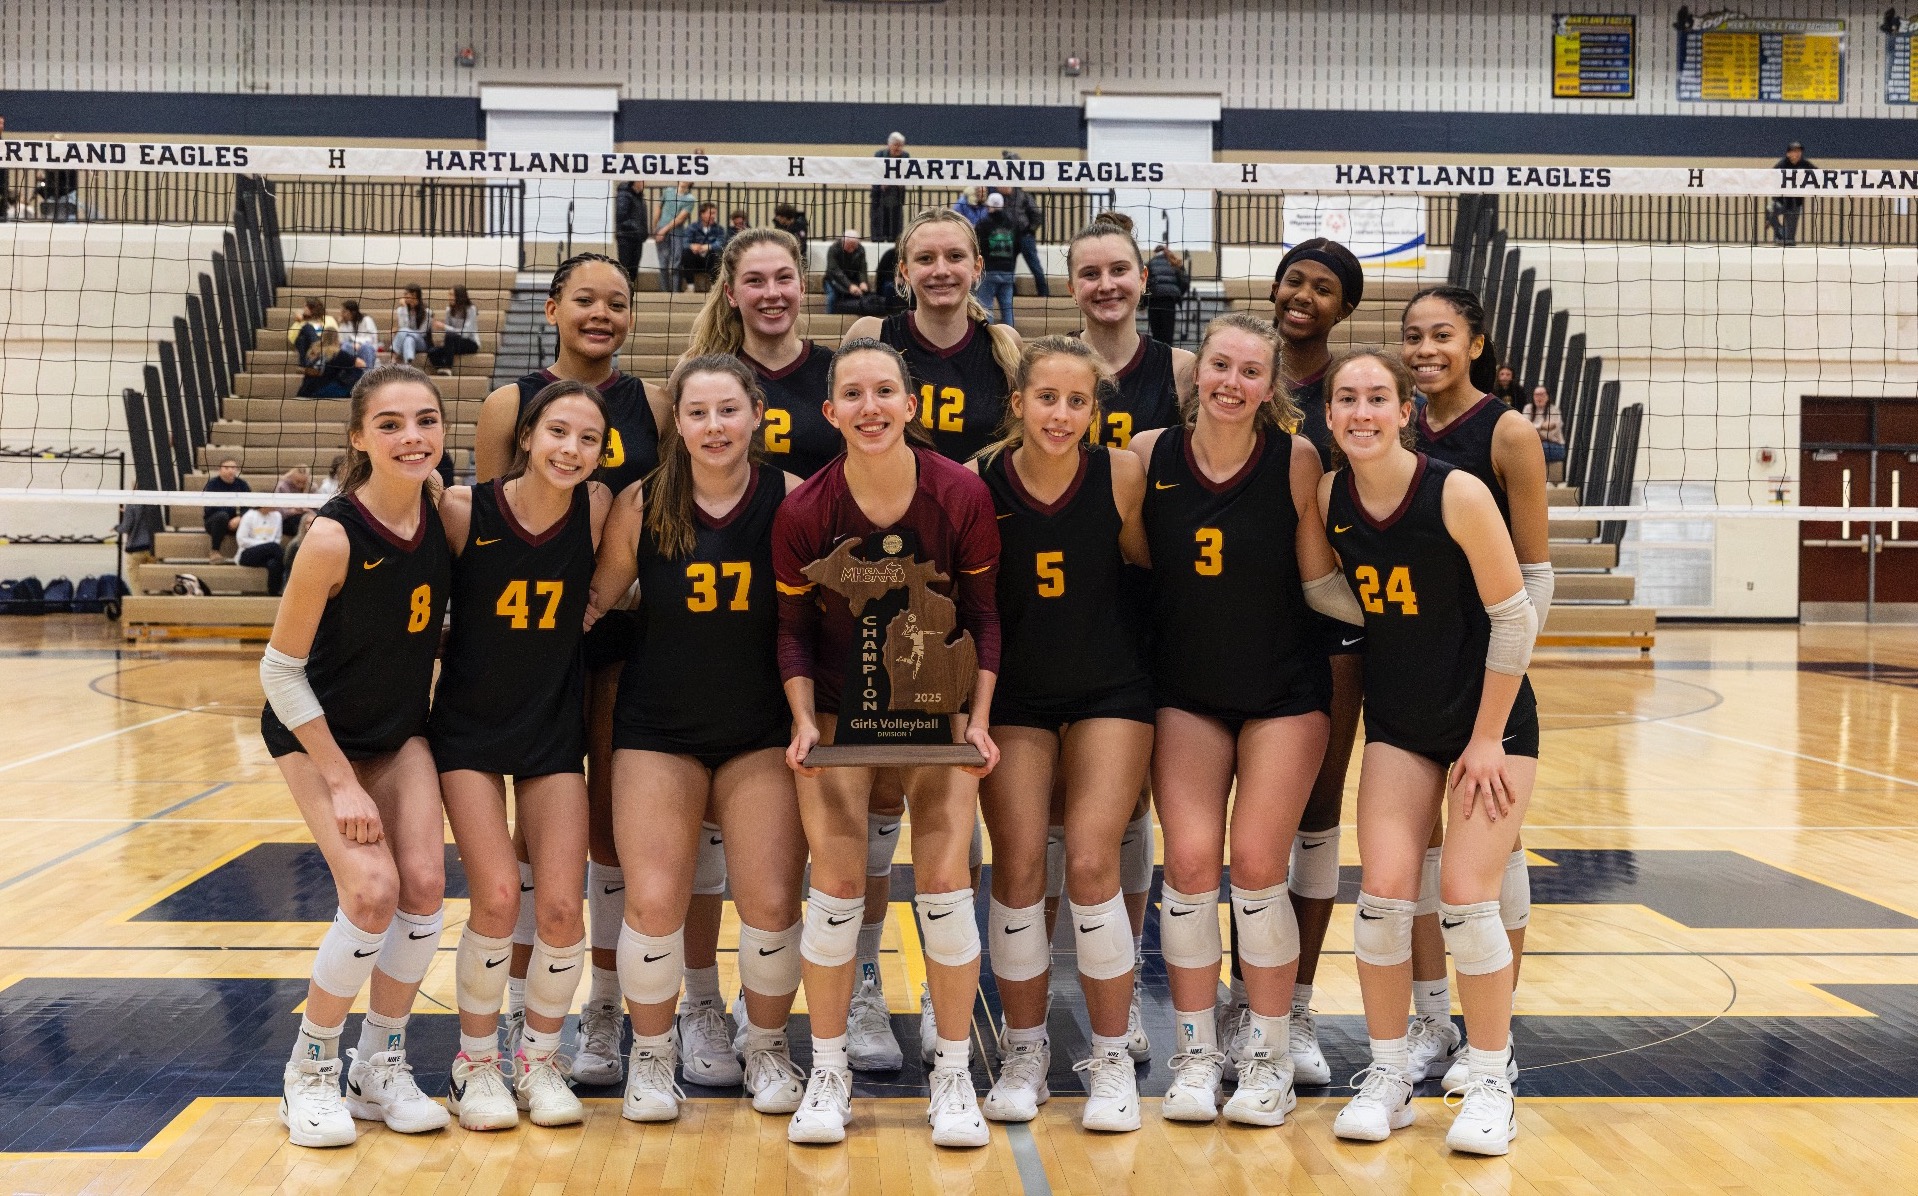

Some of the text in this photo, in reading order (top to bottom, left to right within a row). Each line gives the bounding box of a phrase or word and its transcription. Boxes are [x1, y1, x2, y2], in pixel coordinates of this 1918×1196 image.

[0, 141, 248, 167] RTLAND EAGLES
[328, 149, 346, 169] H
[425, 150, 709, 176] HARTLAND EAGLES
[787, 156, 805, 177] H
[883, 158, 1164, 182] HARTLAND EAGLES
[1241, 163, 1258, 183] H
[1335, 164, 1611, 188] HARTLAND EAGLES
[1687, 169, 1704, 188] H
[918, 384, 965, 433] 12
[763, 408, 791, 454] 2
[1194, 527, 1223, 577] 3
[686, 561, 752, 613] 37
[1036, 551, 1066, 599] 5
[1355, 565, 1420, 615] 24
[407, 583, 431, 634] 8
[495, 580, 564, 629] 47
[862, 615, 878, 711] CHAMPION
[914, 692, 942, 703] 2025
[850, 718, 939, 732] Girls Volleyball
[387, 1055, 401, 1063] NIKE
[1190, 1047, 1203, 1055] NIKE
[319, 1065, 334, 1073] NIKE
